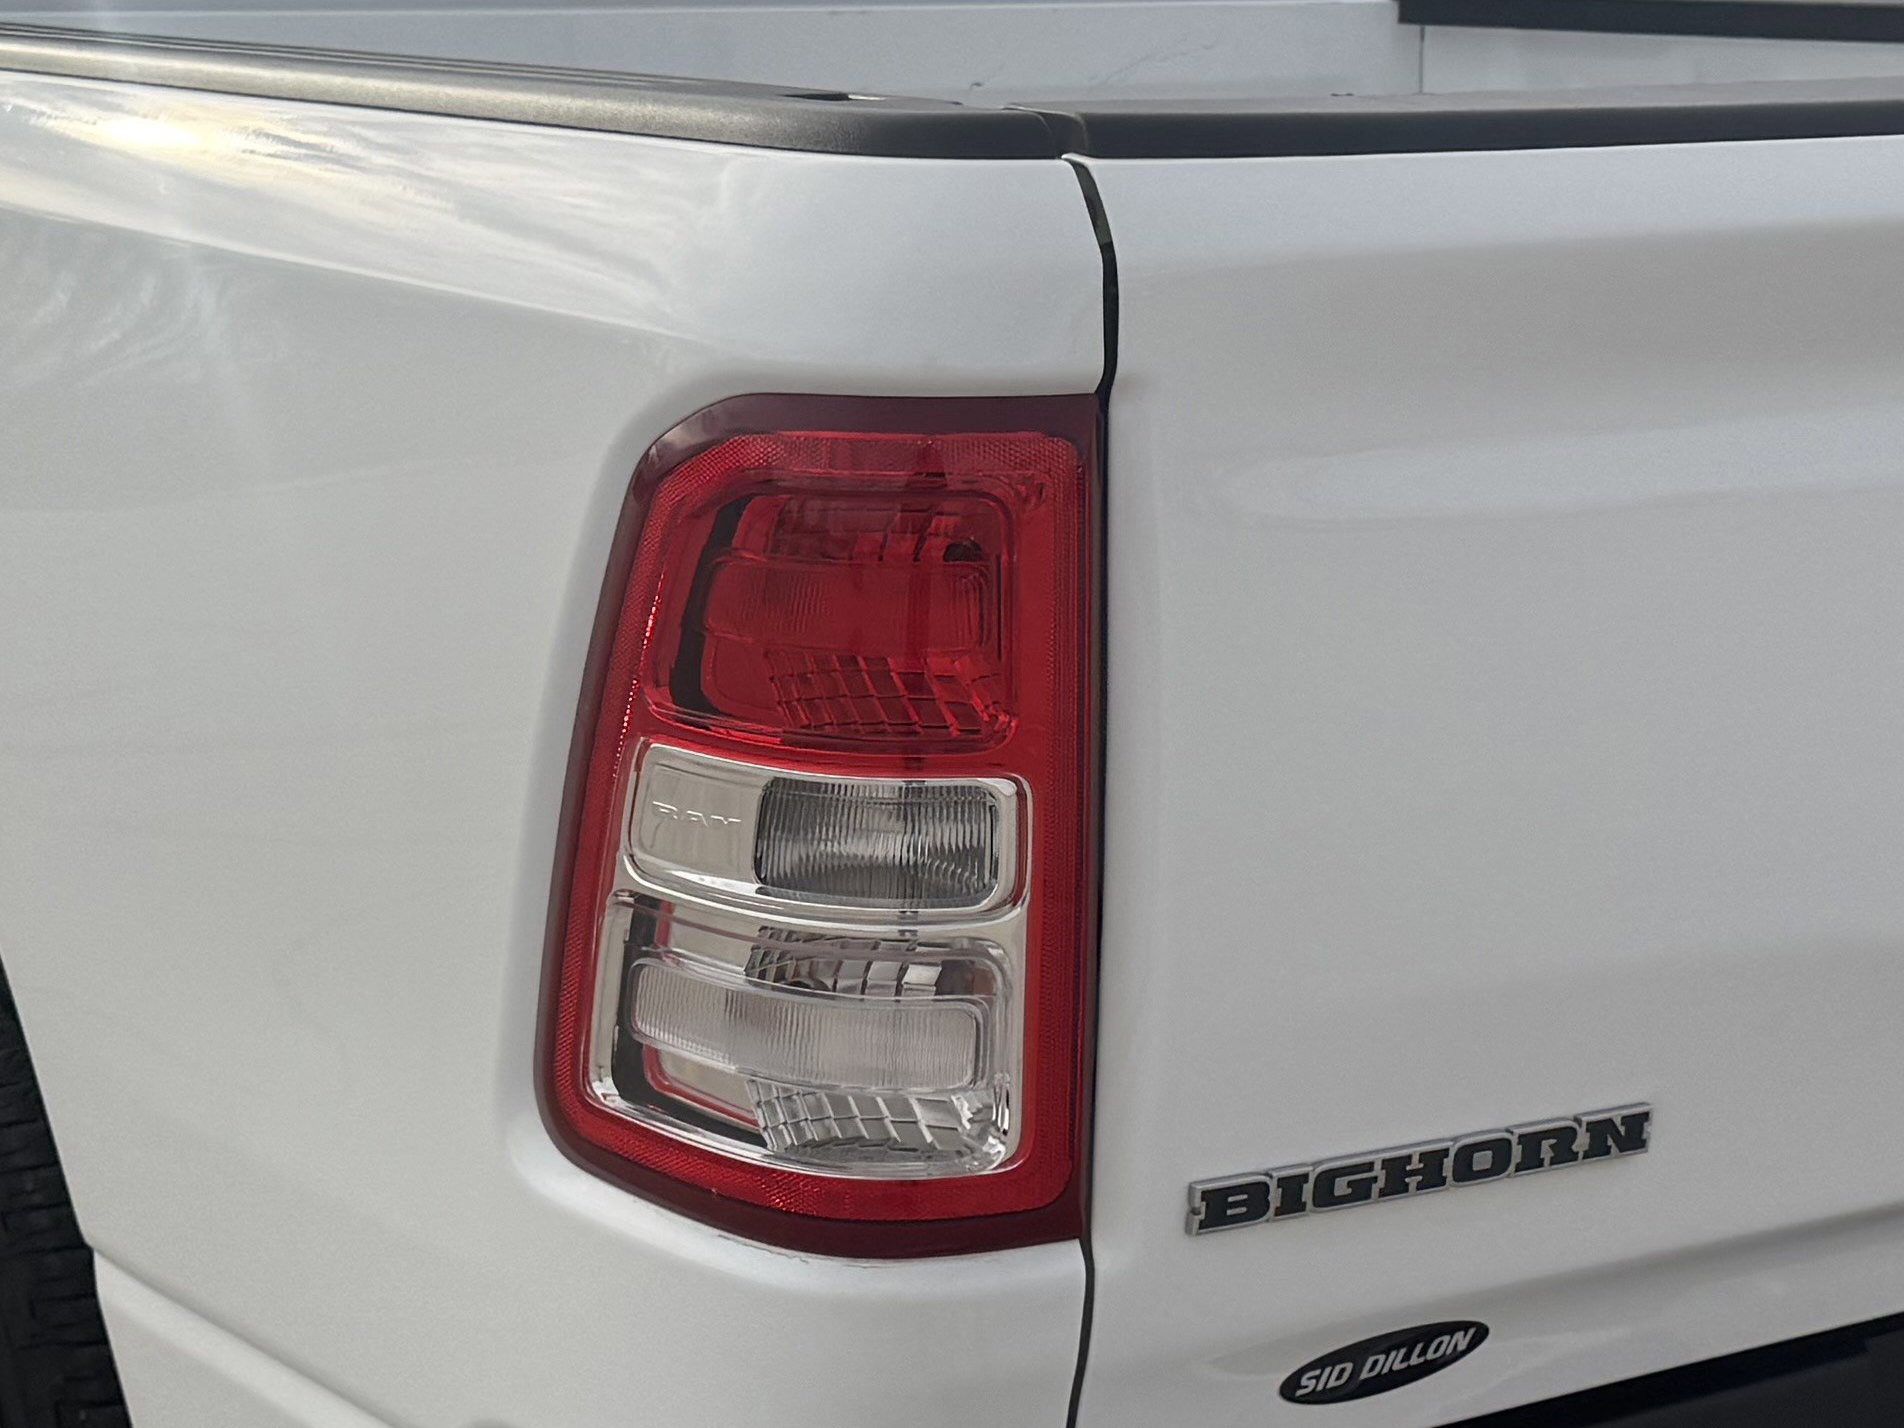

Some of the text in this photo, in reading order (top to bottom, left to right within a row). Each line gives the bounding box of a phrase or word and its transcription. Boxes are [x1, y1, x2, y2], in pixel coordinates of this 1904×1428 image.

[1186, 1103, 1654, 1235] BIGHORN
[1295, 1327, 1476, 1398] SID DILLON
